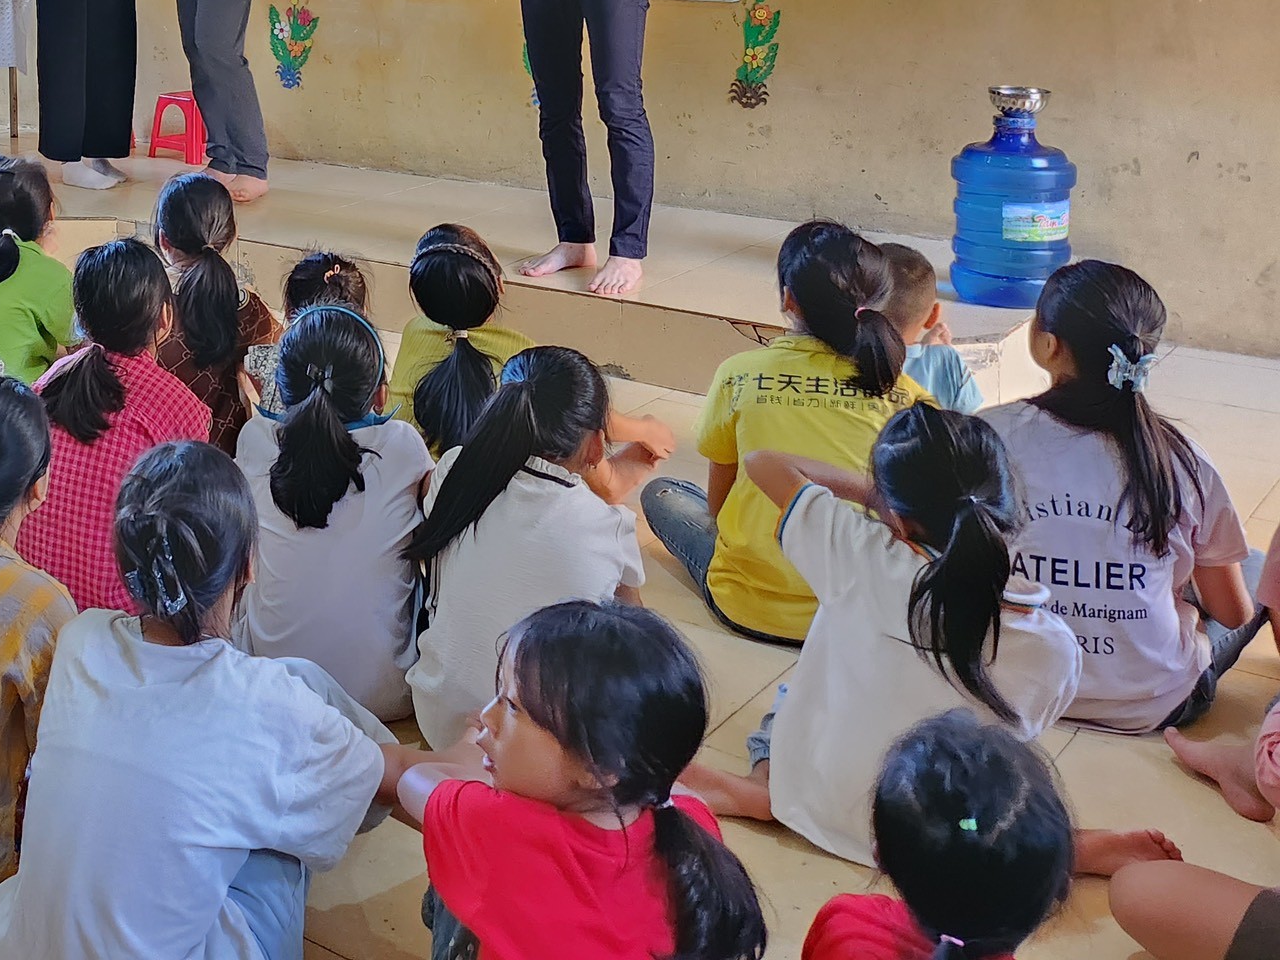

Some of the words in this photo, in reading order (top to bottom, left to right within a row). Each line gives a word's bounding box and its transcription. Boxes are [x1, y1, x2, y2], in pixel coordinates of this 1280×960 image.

[1027, 492, 1114, 522] istian
[1011, 552, 1147, 591] ATELIER
[1051, 601, 1068, 615] de
